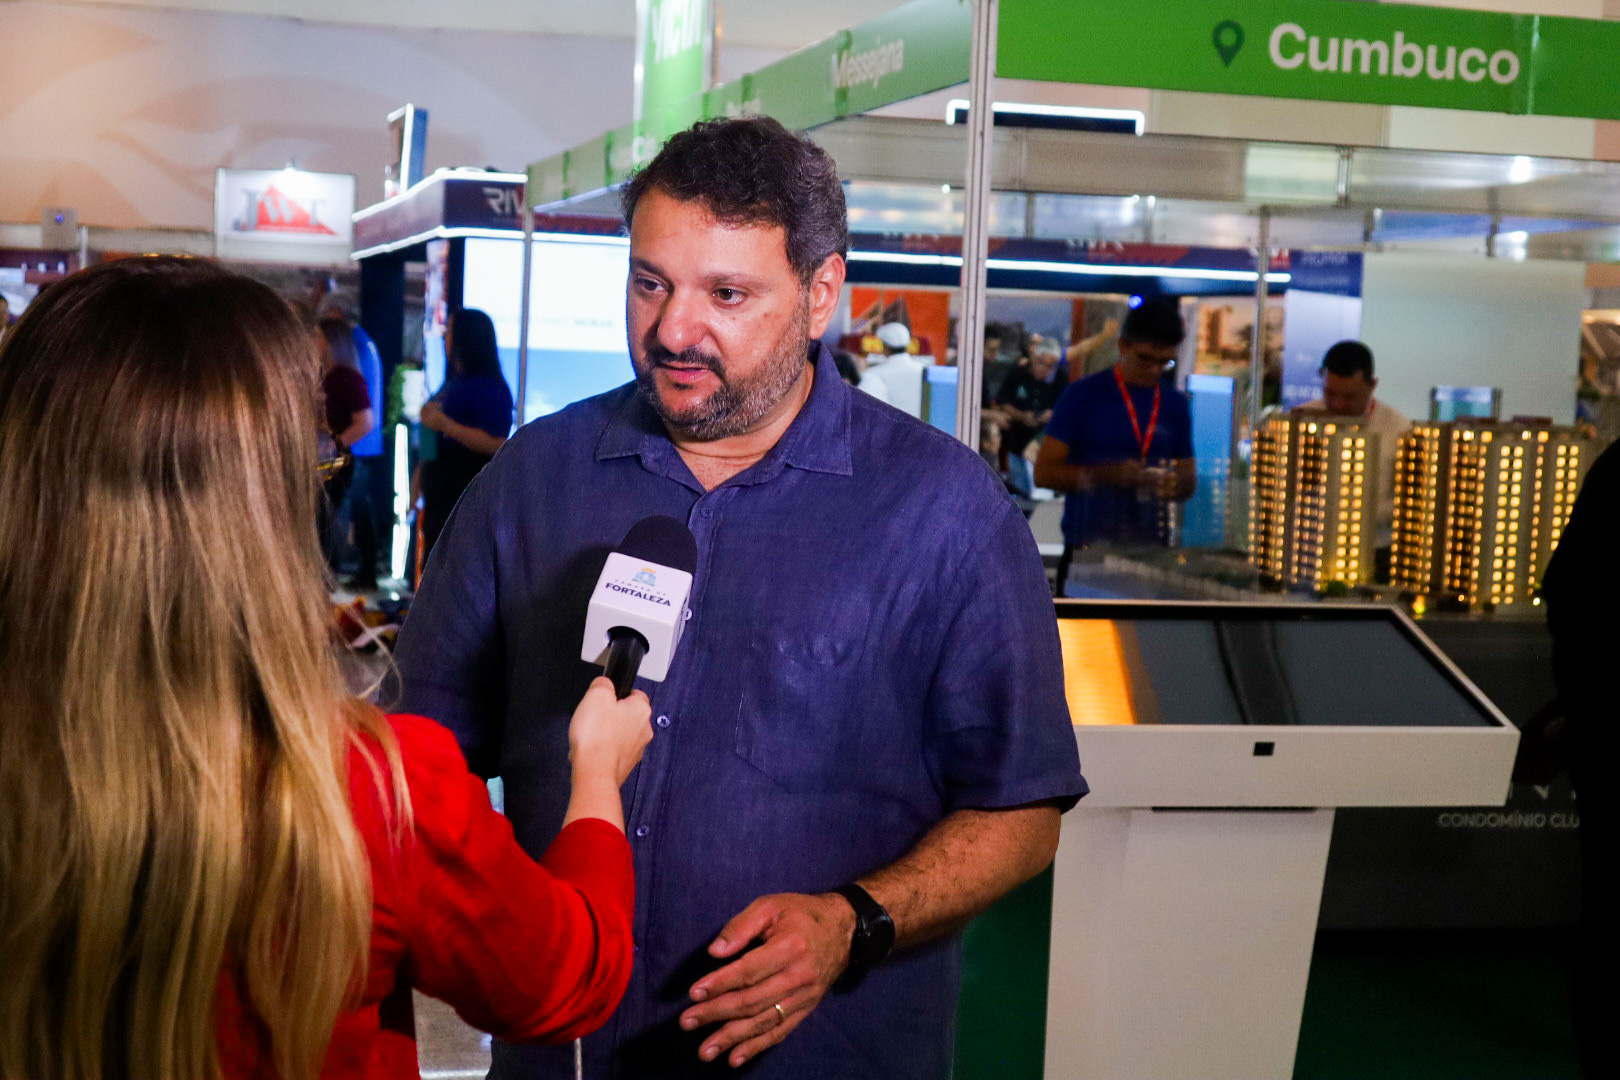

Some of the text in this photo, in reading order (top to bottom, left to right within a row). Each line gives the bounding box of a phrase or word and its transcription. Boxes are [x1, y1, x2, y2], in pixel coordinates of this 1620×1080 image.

[832, 35, 904, 88] Messejana
[1268, 22, 1520, 84] Cumbuco
[482, 187, 526, 214] RIV
[605, 582, 671, 607] FORTALEZA
[1438, 810, 1580, 828] CONDOMÍNIO CLU
